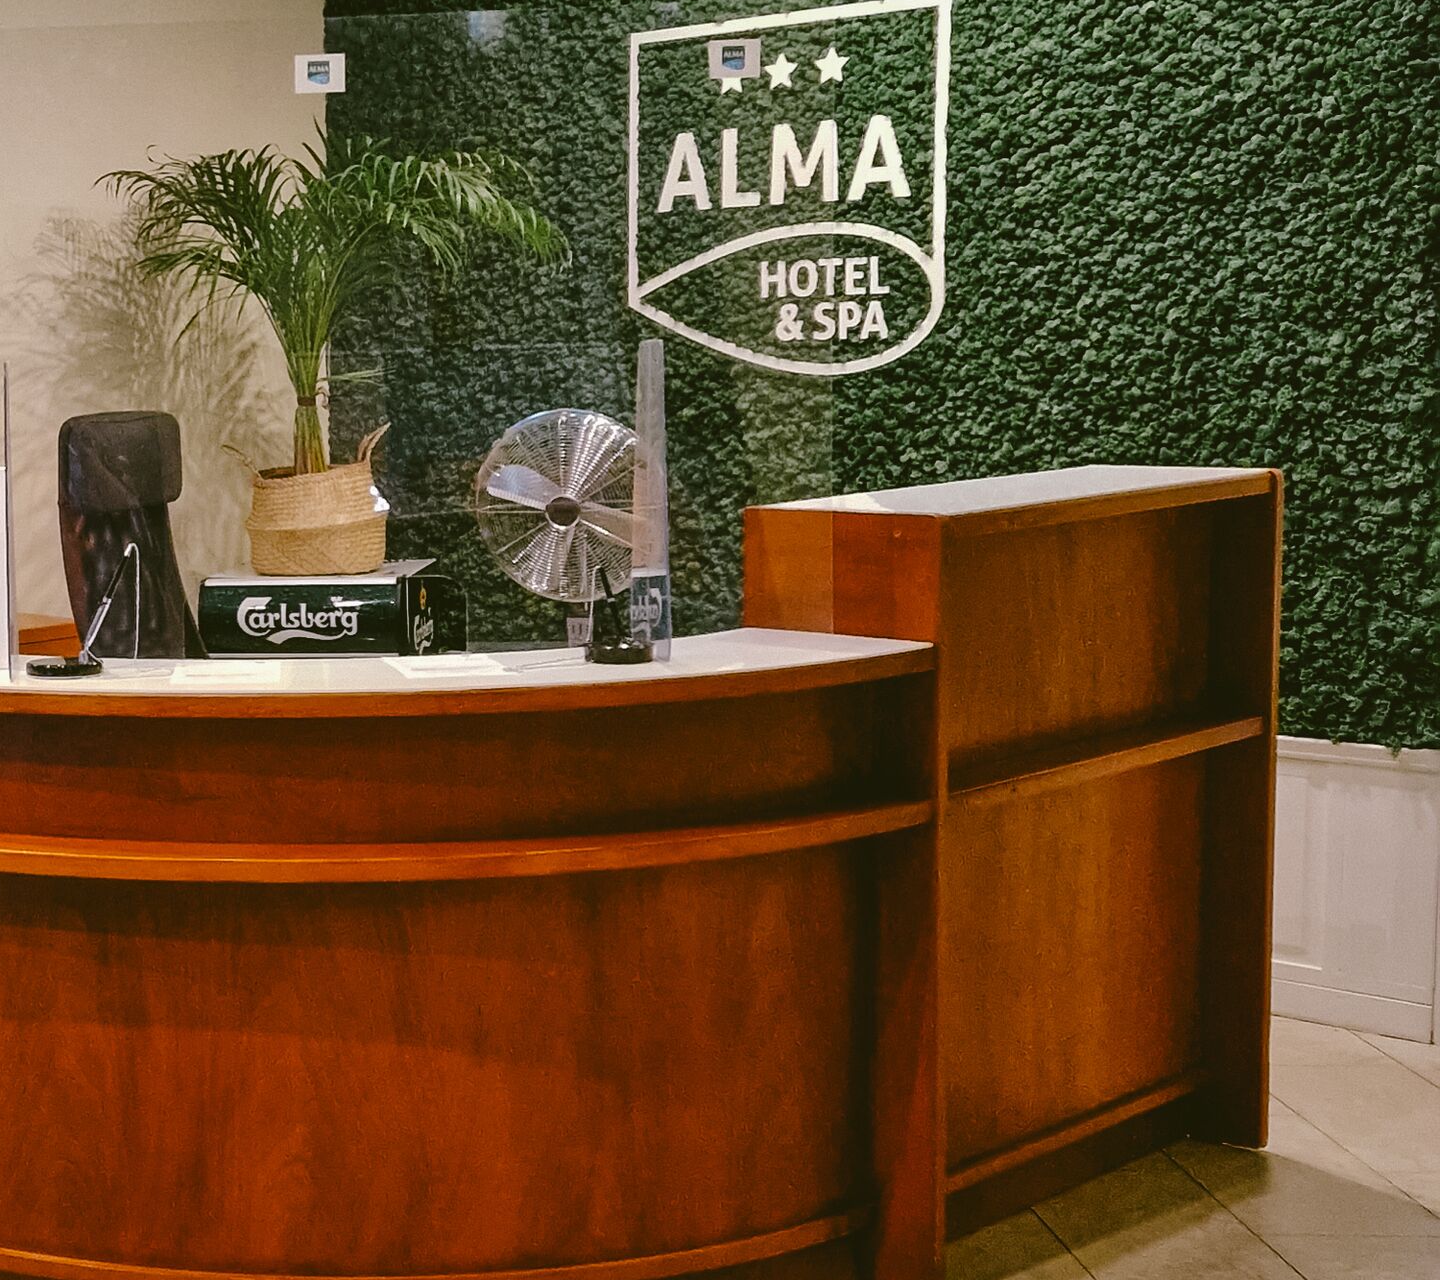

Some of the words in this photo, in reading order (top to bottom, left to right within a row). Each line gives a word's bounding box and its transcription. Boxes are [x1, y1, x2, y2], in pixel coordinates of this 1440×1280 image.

[658, 114, 912, 213] ALMA
[760, 256, 890, 299] HOTEL
[236, 596, 360, 638] Carlsberg
